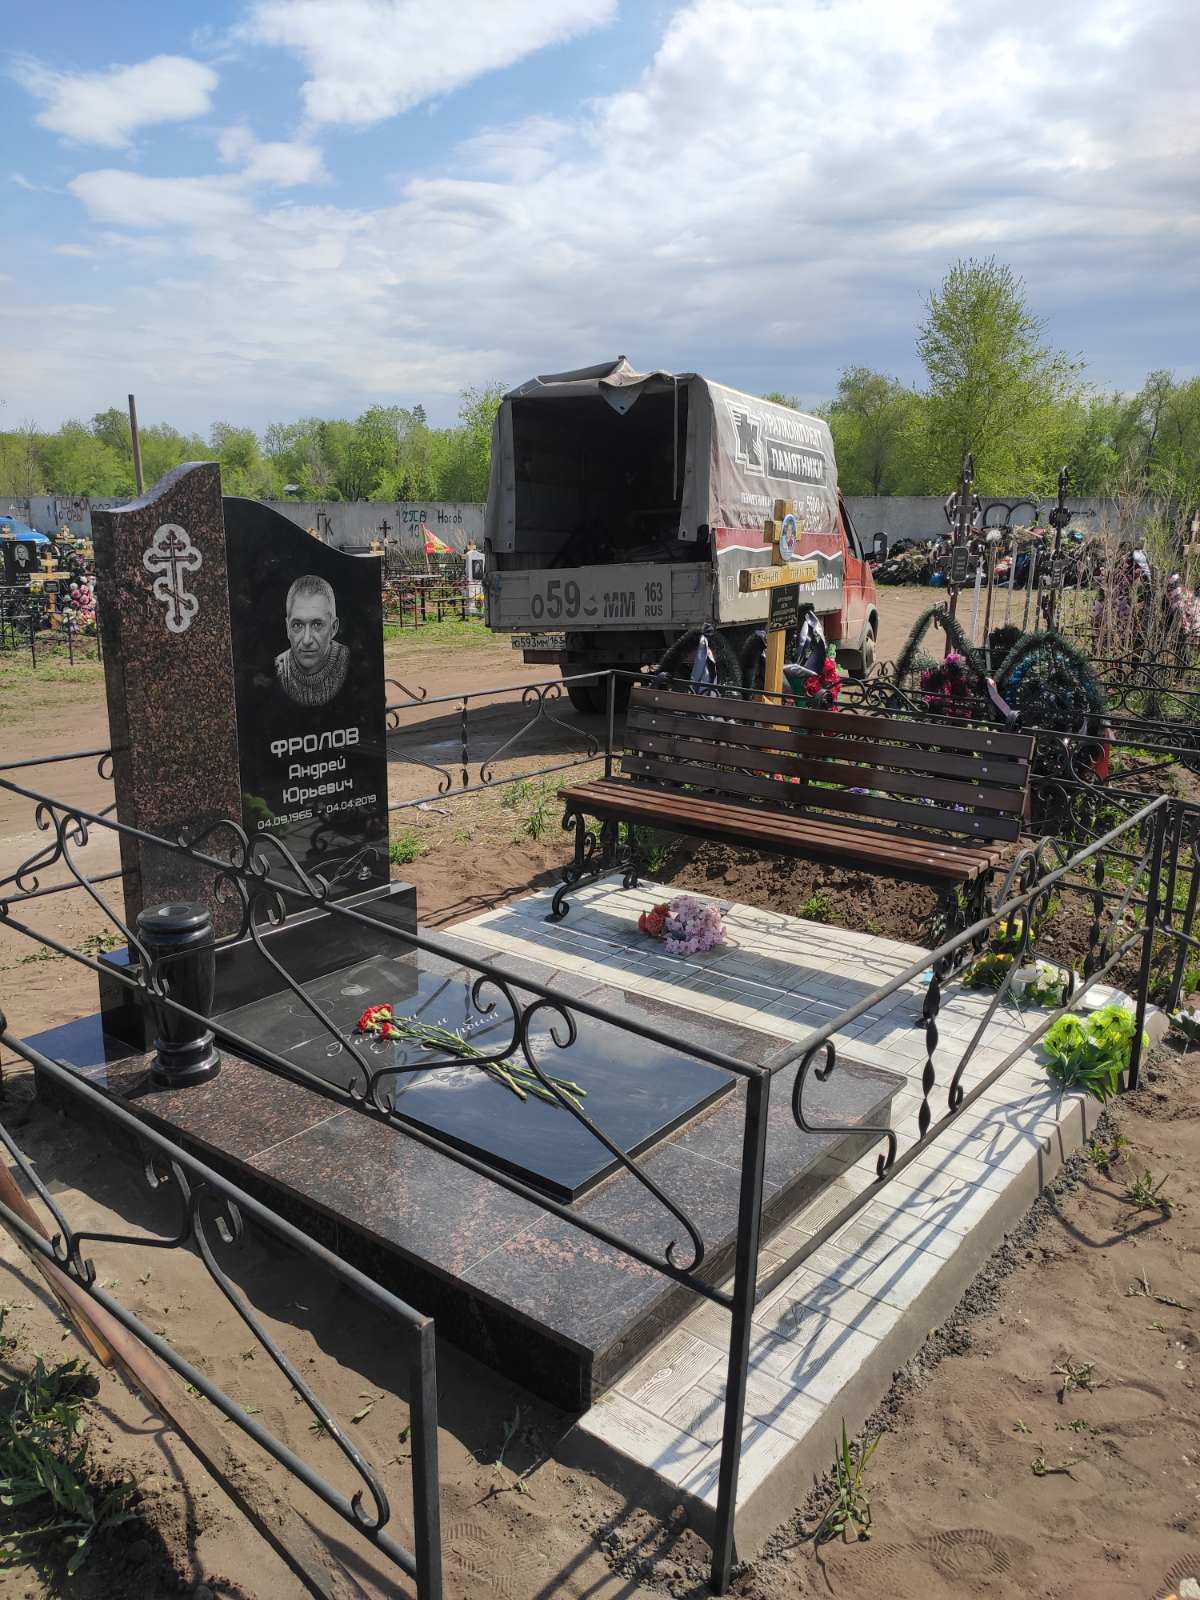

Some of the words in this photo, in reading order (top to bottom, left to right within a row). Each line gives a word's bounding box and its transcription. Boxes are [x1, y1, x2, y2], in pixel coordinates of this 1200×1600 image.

[771, 447, 823, 480] ПАМЯТНИКИ
[644, 582, 663, 602] 163
[644, 604, 664, 617] RUS
[270, 727, 360, 758] ФРОЛОВ
[288, 755, 347, 780] Андрей
[282, 778, 353, 805] Юрьевич
[257, 809, 313, 830] 04.09.1965
[326, 794, 377, 814] 04.04.2019
